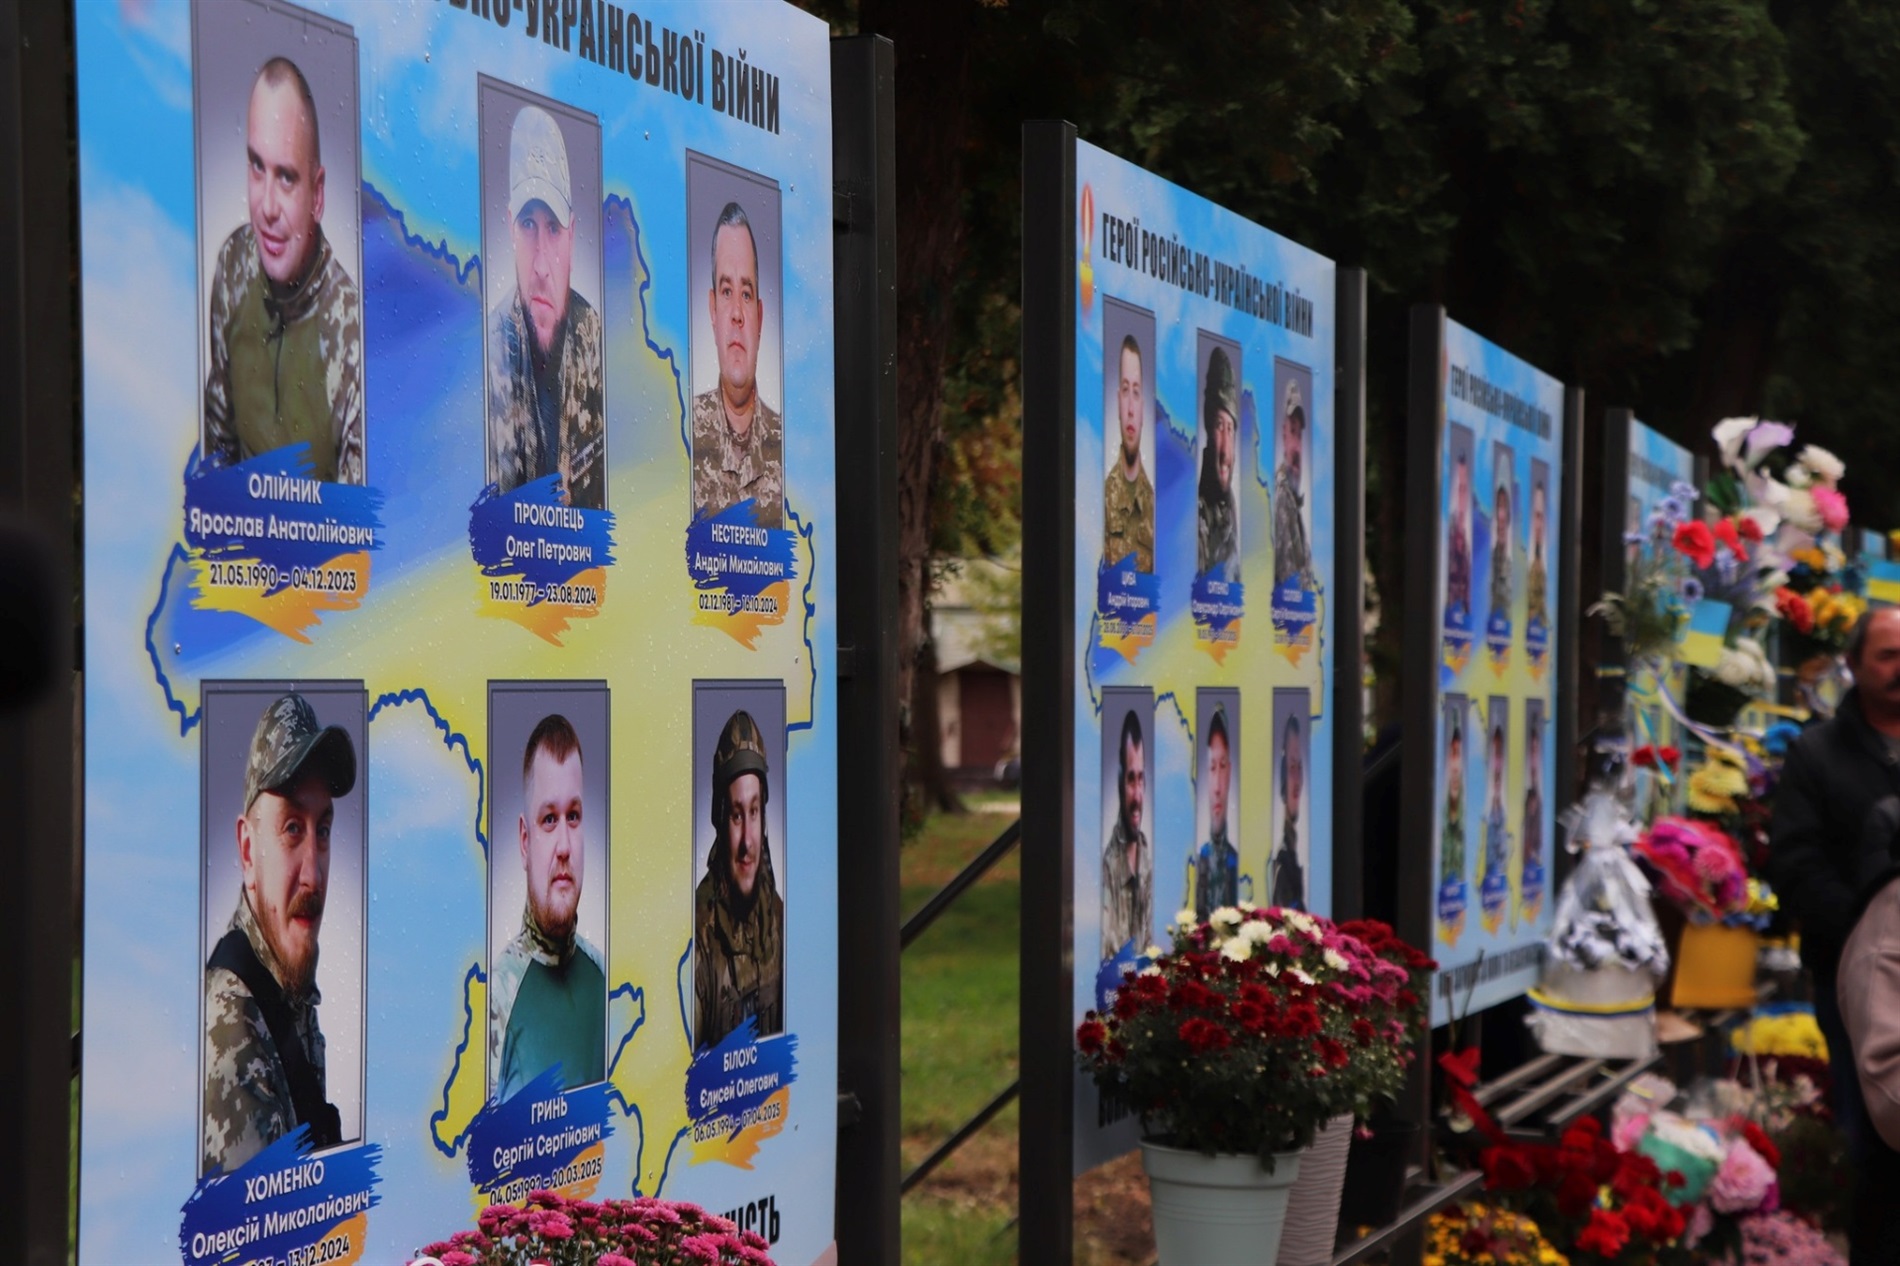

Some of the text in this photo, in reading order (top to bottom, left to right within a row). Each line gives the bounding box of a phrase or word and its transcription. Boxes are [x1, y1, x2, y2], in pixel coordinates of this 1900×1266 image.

[712, 47, 780, 135] ВІЙНИ
[1102, 212, 1314, 339] ГЕРОЇ РОСІЙСЬКО-УКРАЇНСЬКОЇ ВІЙНИ
[249, 471, 322, 504] ОЛІЙНИК
[190, 507, 373, 545] Ярослав Анатолійович
[514, 502, 584, 531] ПРОКОПЕЦЬ
[506, 534, 592, 565] Олег Петрович
[711, 523, 768, 547] НЕСТЕРЕНКО
[210, 564, 277, 588] 21.05.1990
[293, 567, 357, 591] 04.12.2023
[694, 552, 783, 577] Андрій Михайлович
[490, 581, 536, 602] 19.01.1977
[546, 585, 597, 605] 23.08.2024
[723, 1046, 758, 1072] БІЛОУС
[700, 1072, 779, 1108] Єлисей Олегович
[531, 1096, 568, 1125] ГРИНЬ
[493, 1123, 601, 1170] Сергій Сергійович
[245, 1160, 324, 1204] ХОМЕНКО
[552, 1157, 602, 1189] 20.03.2025
[192, 1190, 370, 1259] Олексій Миколайович
[720, 1195, 781, 1245] ІСТЬ
[288, 1236, 350, 1266] 13.12.2024
